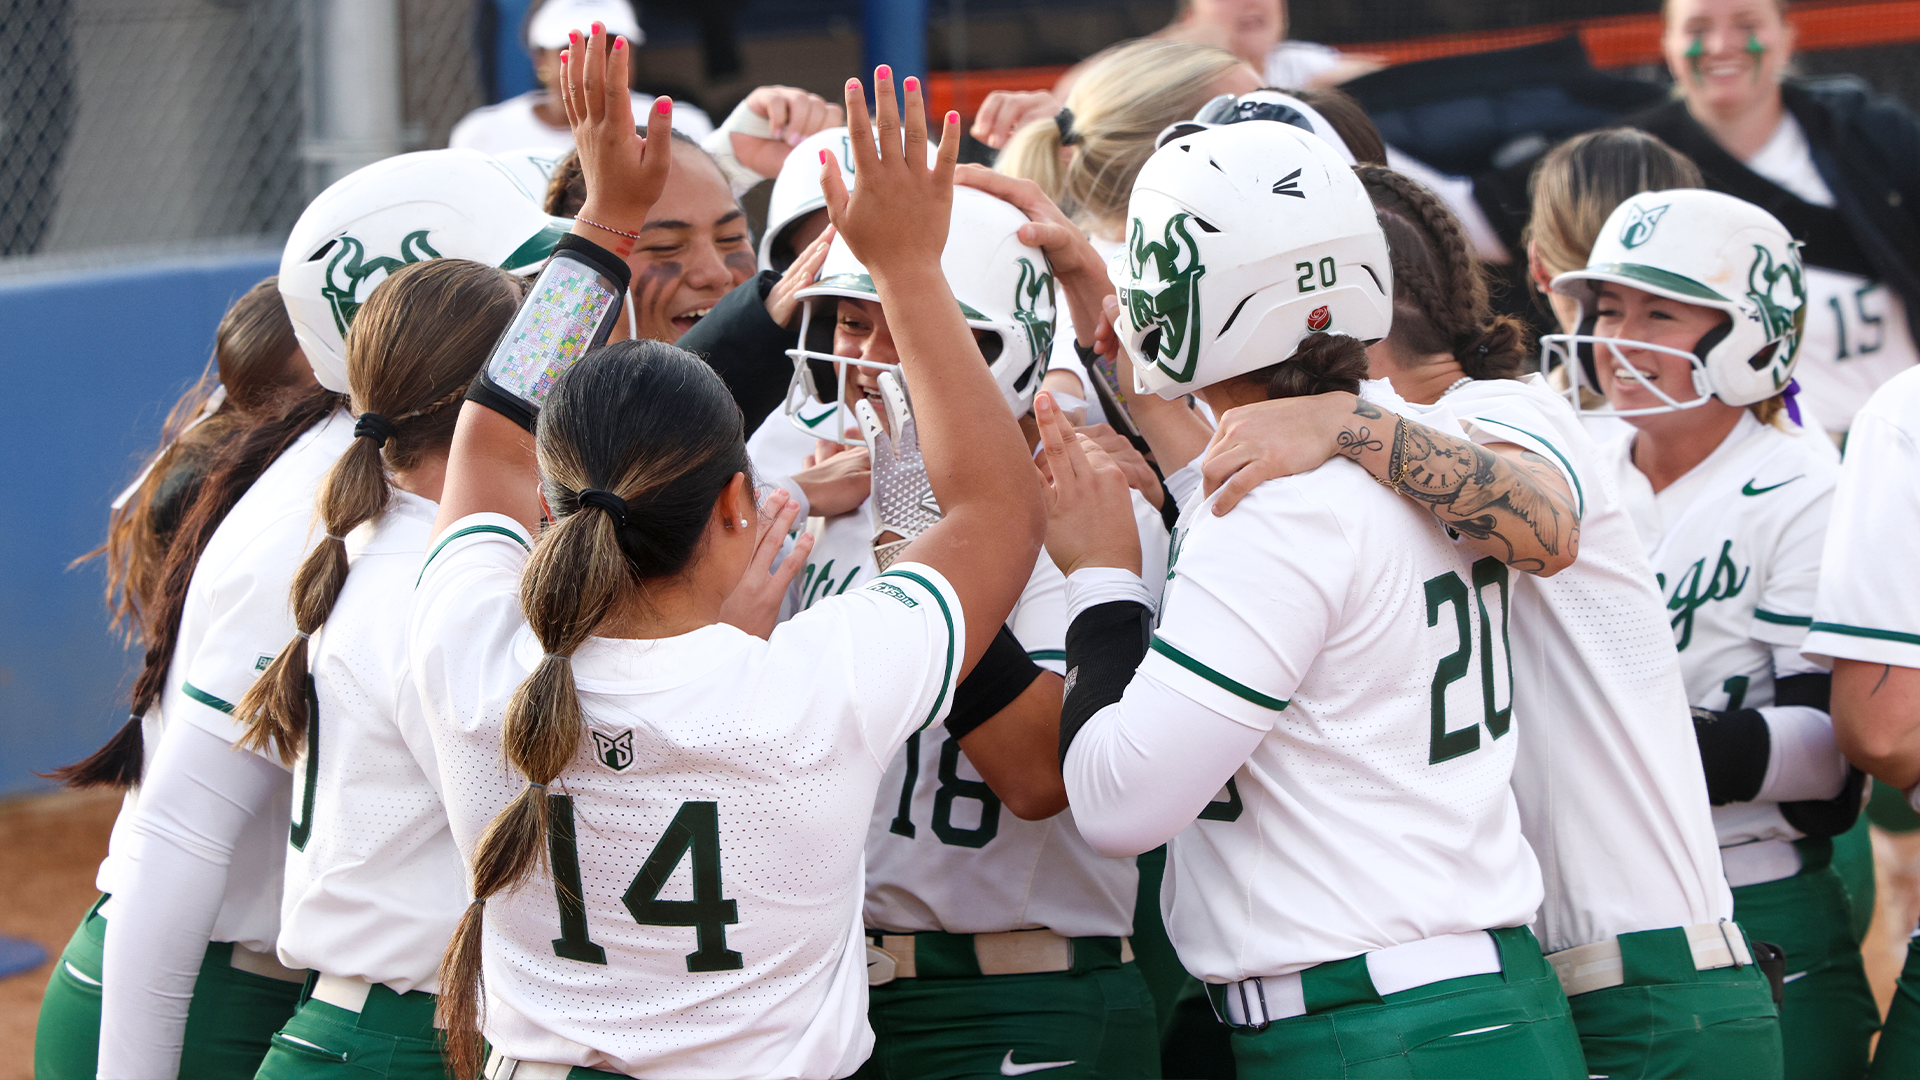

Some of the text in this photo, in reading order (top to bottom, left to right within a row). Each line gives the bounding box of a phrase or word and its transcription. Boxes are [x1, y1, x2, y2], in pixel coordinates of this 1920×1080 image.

[1296, 256, 1337, 293] 20
[1828, 283, 1884, 361] 15
[1423, 555, 1514, 766] 20
[592, 729, 634, 771] PS
[889, 730, 1002, 849] 18
[547, 793, 744, 973] 14
